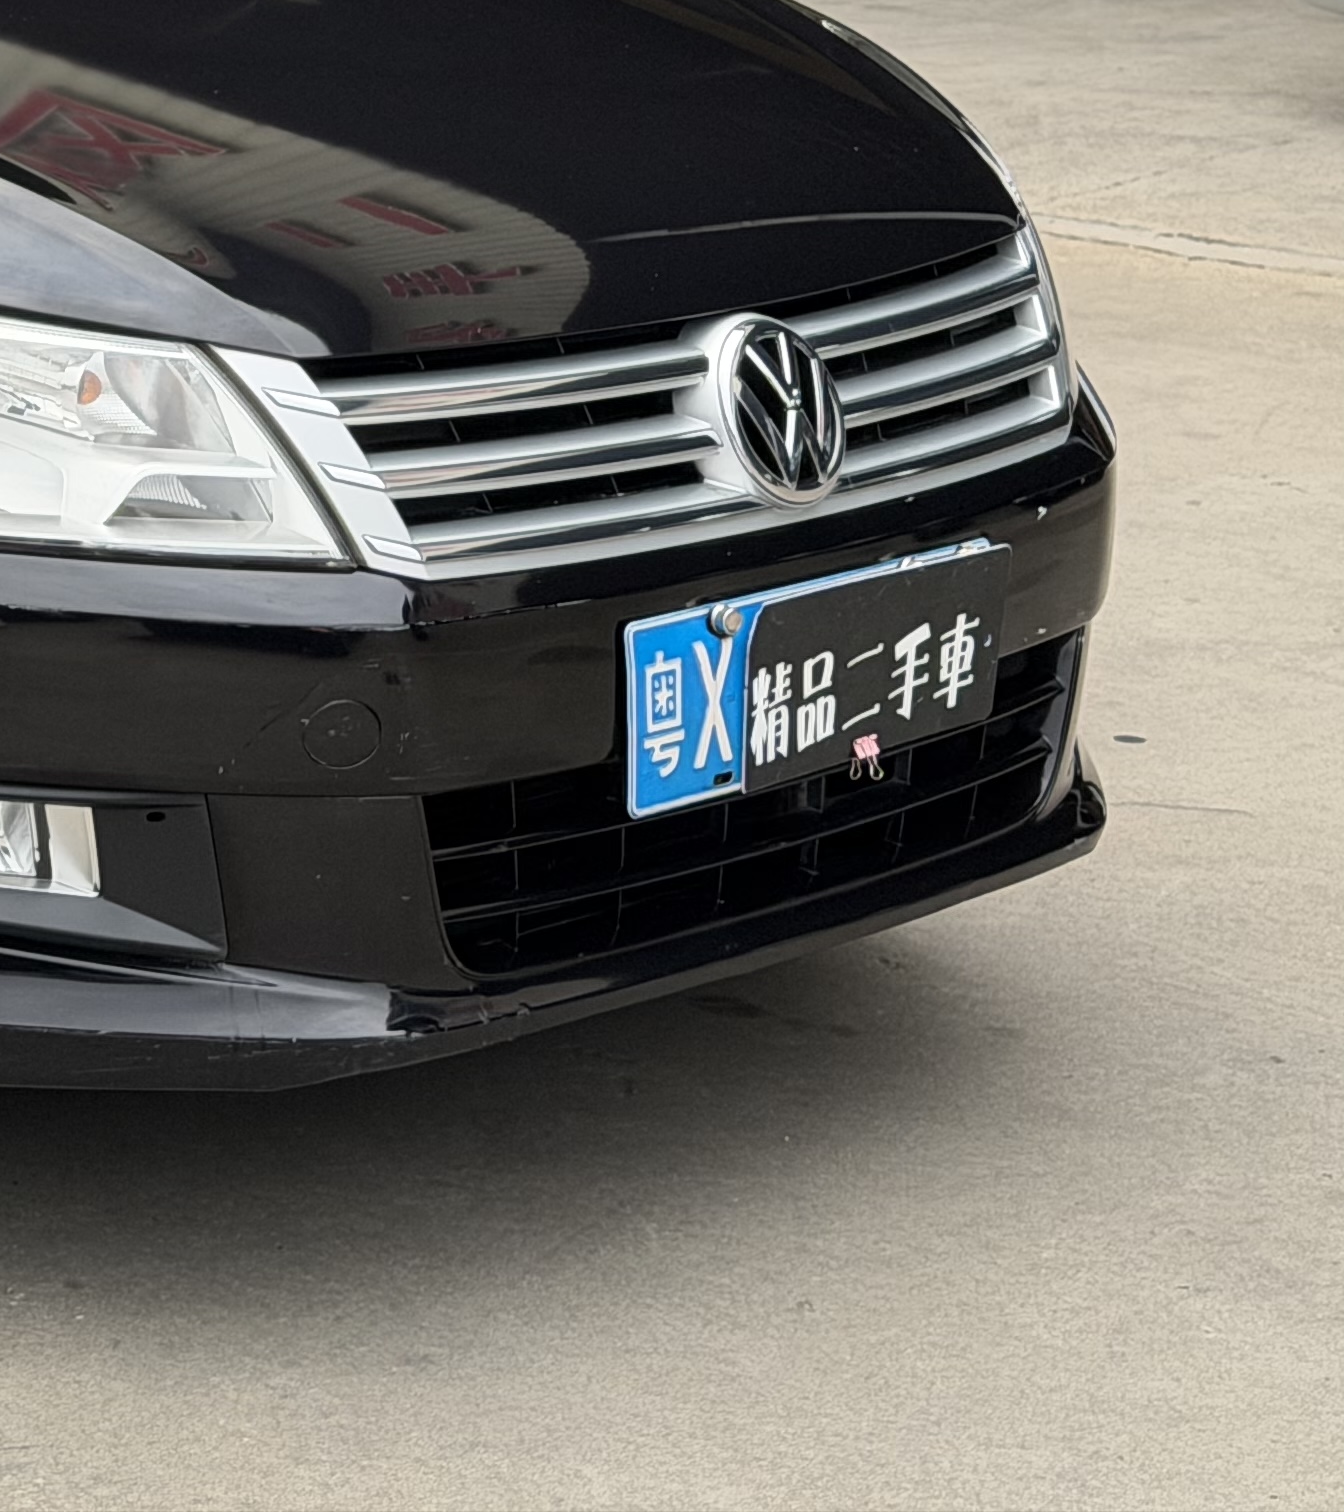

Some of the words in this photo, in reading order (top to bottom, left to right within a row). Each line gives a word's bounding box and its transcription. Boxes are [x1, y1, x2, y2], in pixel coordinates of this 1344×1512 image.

[749, 612, 981, 767] 精品二手車
